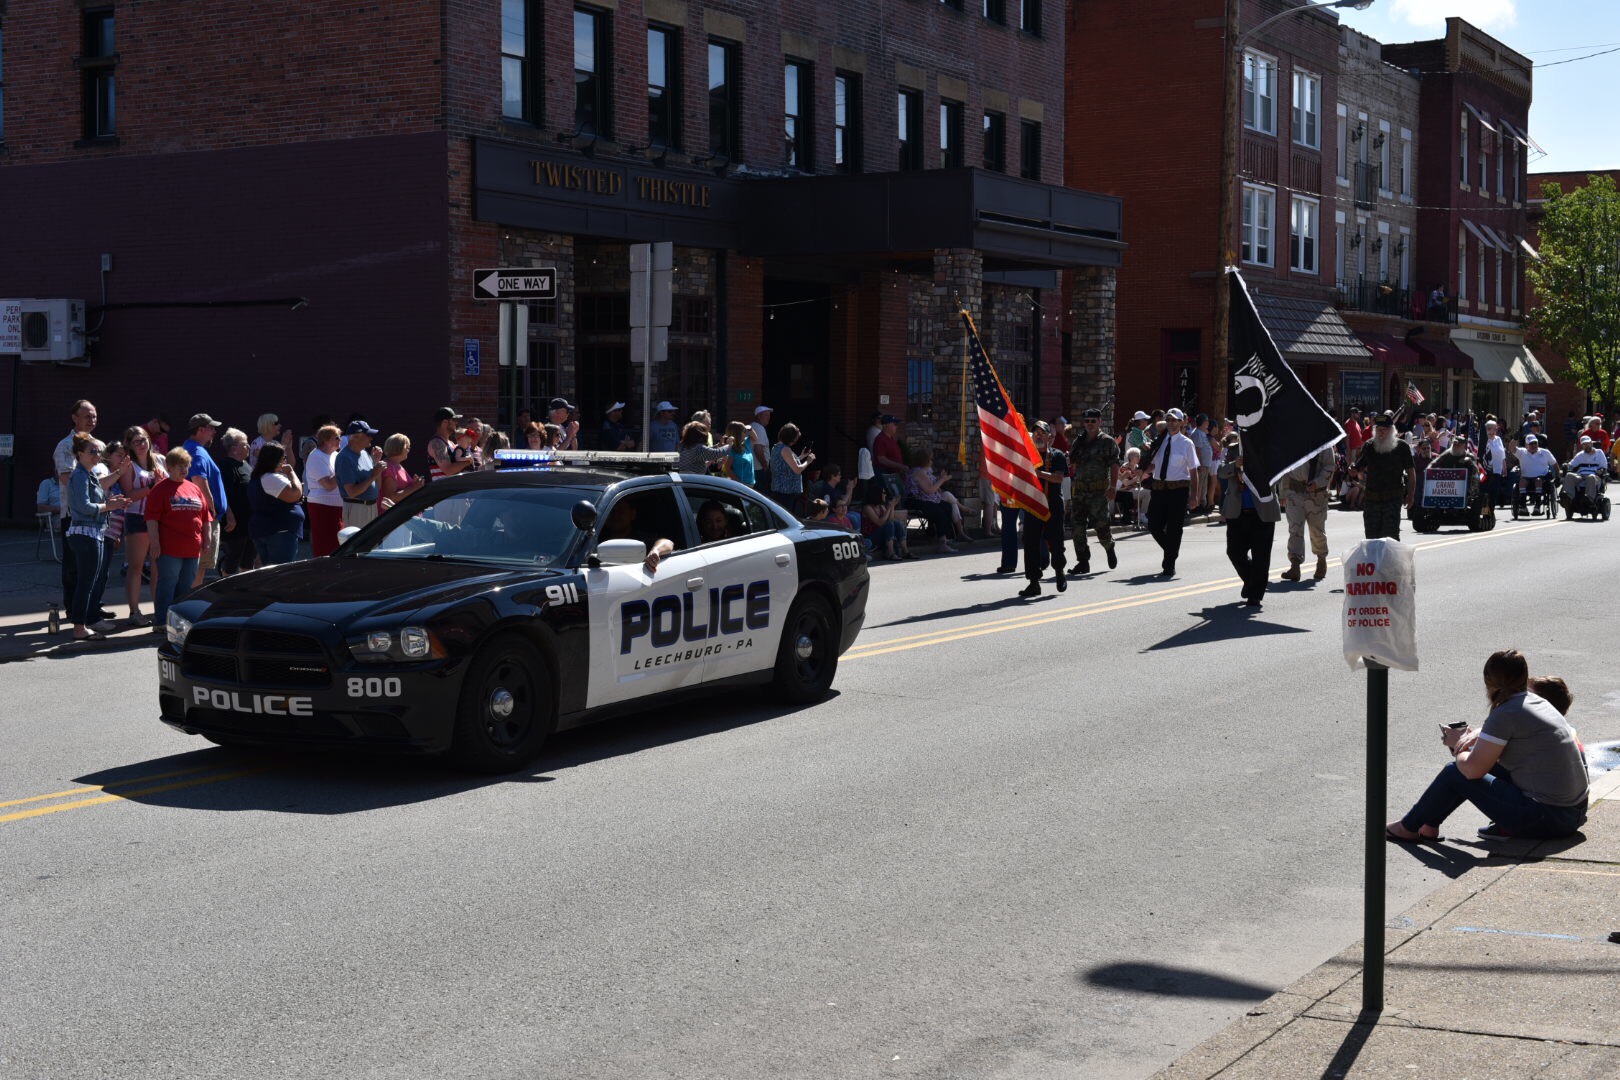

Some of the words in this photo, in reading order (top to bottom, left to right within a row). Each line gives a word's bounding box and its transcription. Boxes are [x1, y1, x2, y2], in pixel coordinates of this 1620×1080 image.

[530, 159, 622, 196] TWISTED
[636, 175, 711, 208] THISTLE
[498, 278, 520, 290] ONE
[524, 277, 546, 289] WAY
[1432, 488, 1458, 496] MARSHAL
[1435, 480, 1456, 488] GRAND
[832, 541, 860, 560] 800
[1356, 562, 1376, 577] NO
[545, 582, 579, 607] 911
[620, 579, 770, 655] POLICE
[1359, 606, 1389, 615] ORDER
[1347, 619, 1357, 627] OF
[1358, 618, 1391, 627] POLICE
[634, 643, 722, 670] LEECHBURG
[736, 638, 753, 649] PA
[161, 659, 176, 682] 911
[346, 677, 402, 698] 800
[192, 685, 314, 716] POLICE
